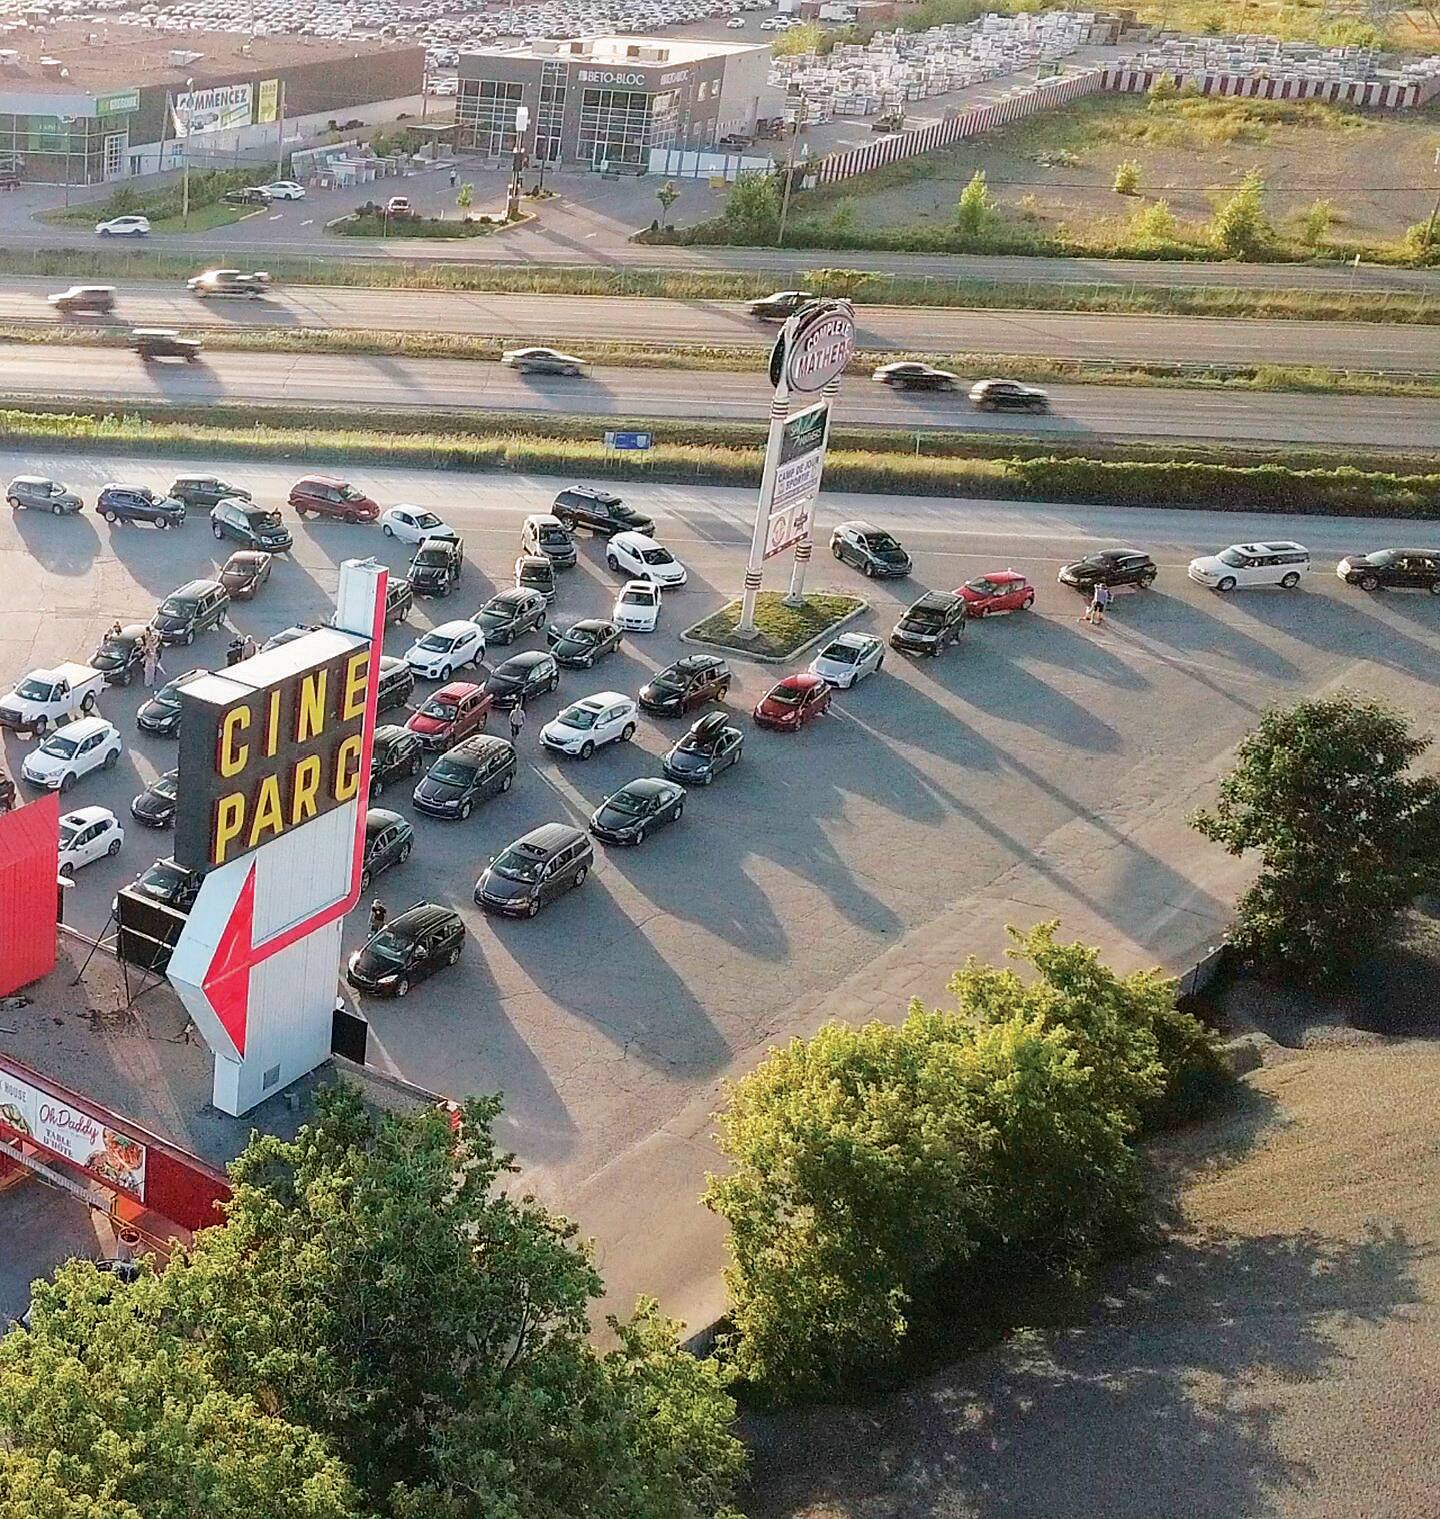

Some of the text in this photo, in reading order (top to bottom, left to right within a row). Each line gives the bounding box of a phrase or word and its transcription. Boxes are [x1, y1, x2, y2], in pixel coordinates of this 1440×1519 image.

[588, 71, 645, 86] BETO-BLOC
[217, 650, 369, 779] CINE
[213, 734, 361, 865] PARC
[4, 1082, 27, 1103] HOUSE
[39, 1104, 100, 1146] Oh Daddy
[45, 1127, 72, 1148] TABLE
